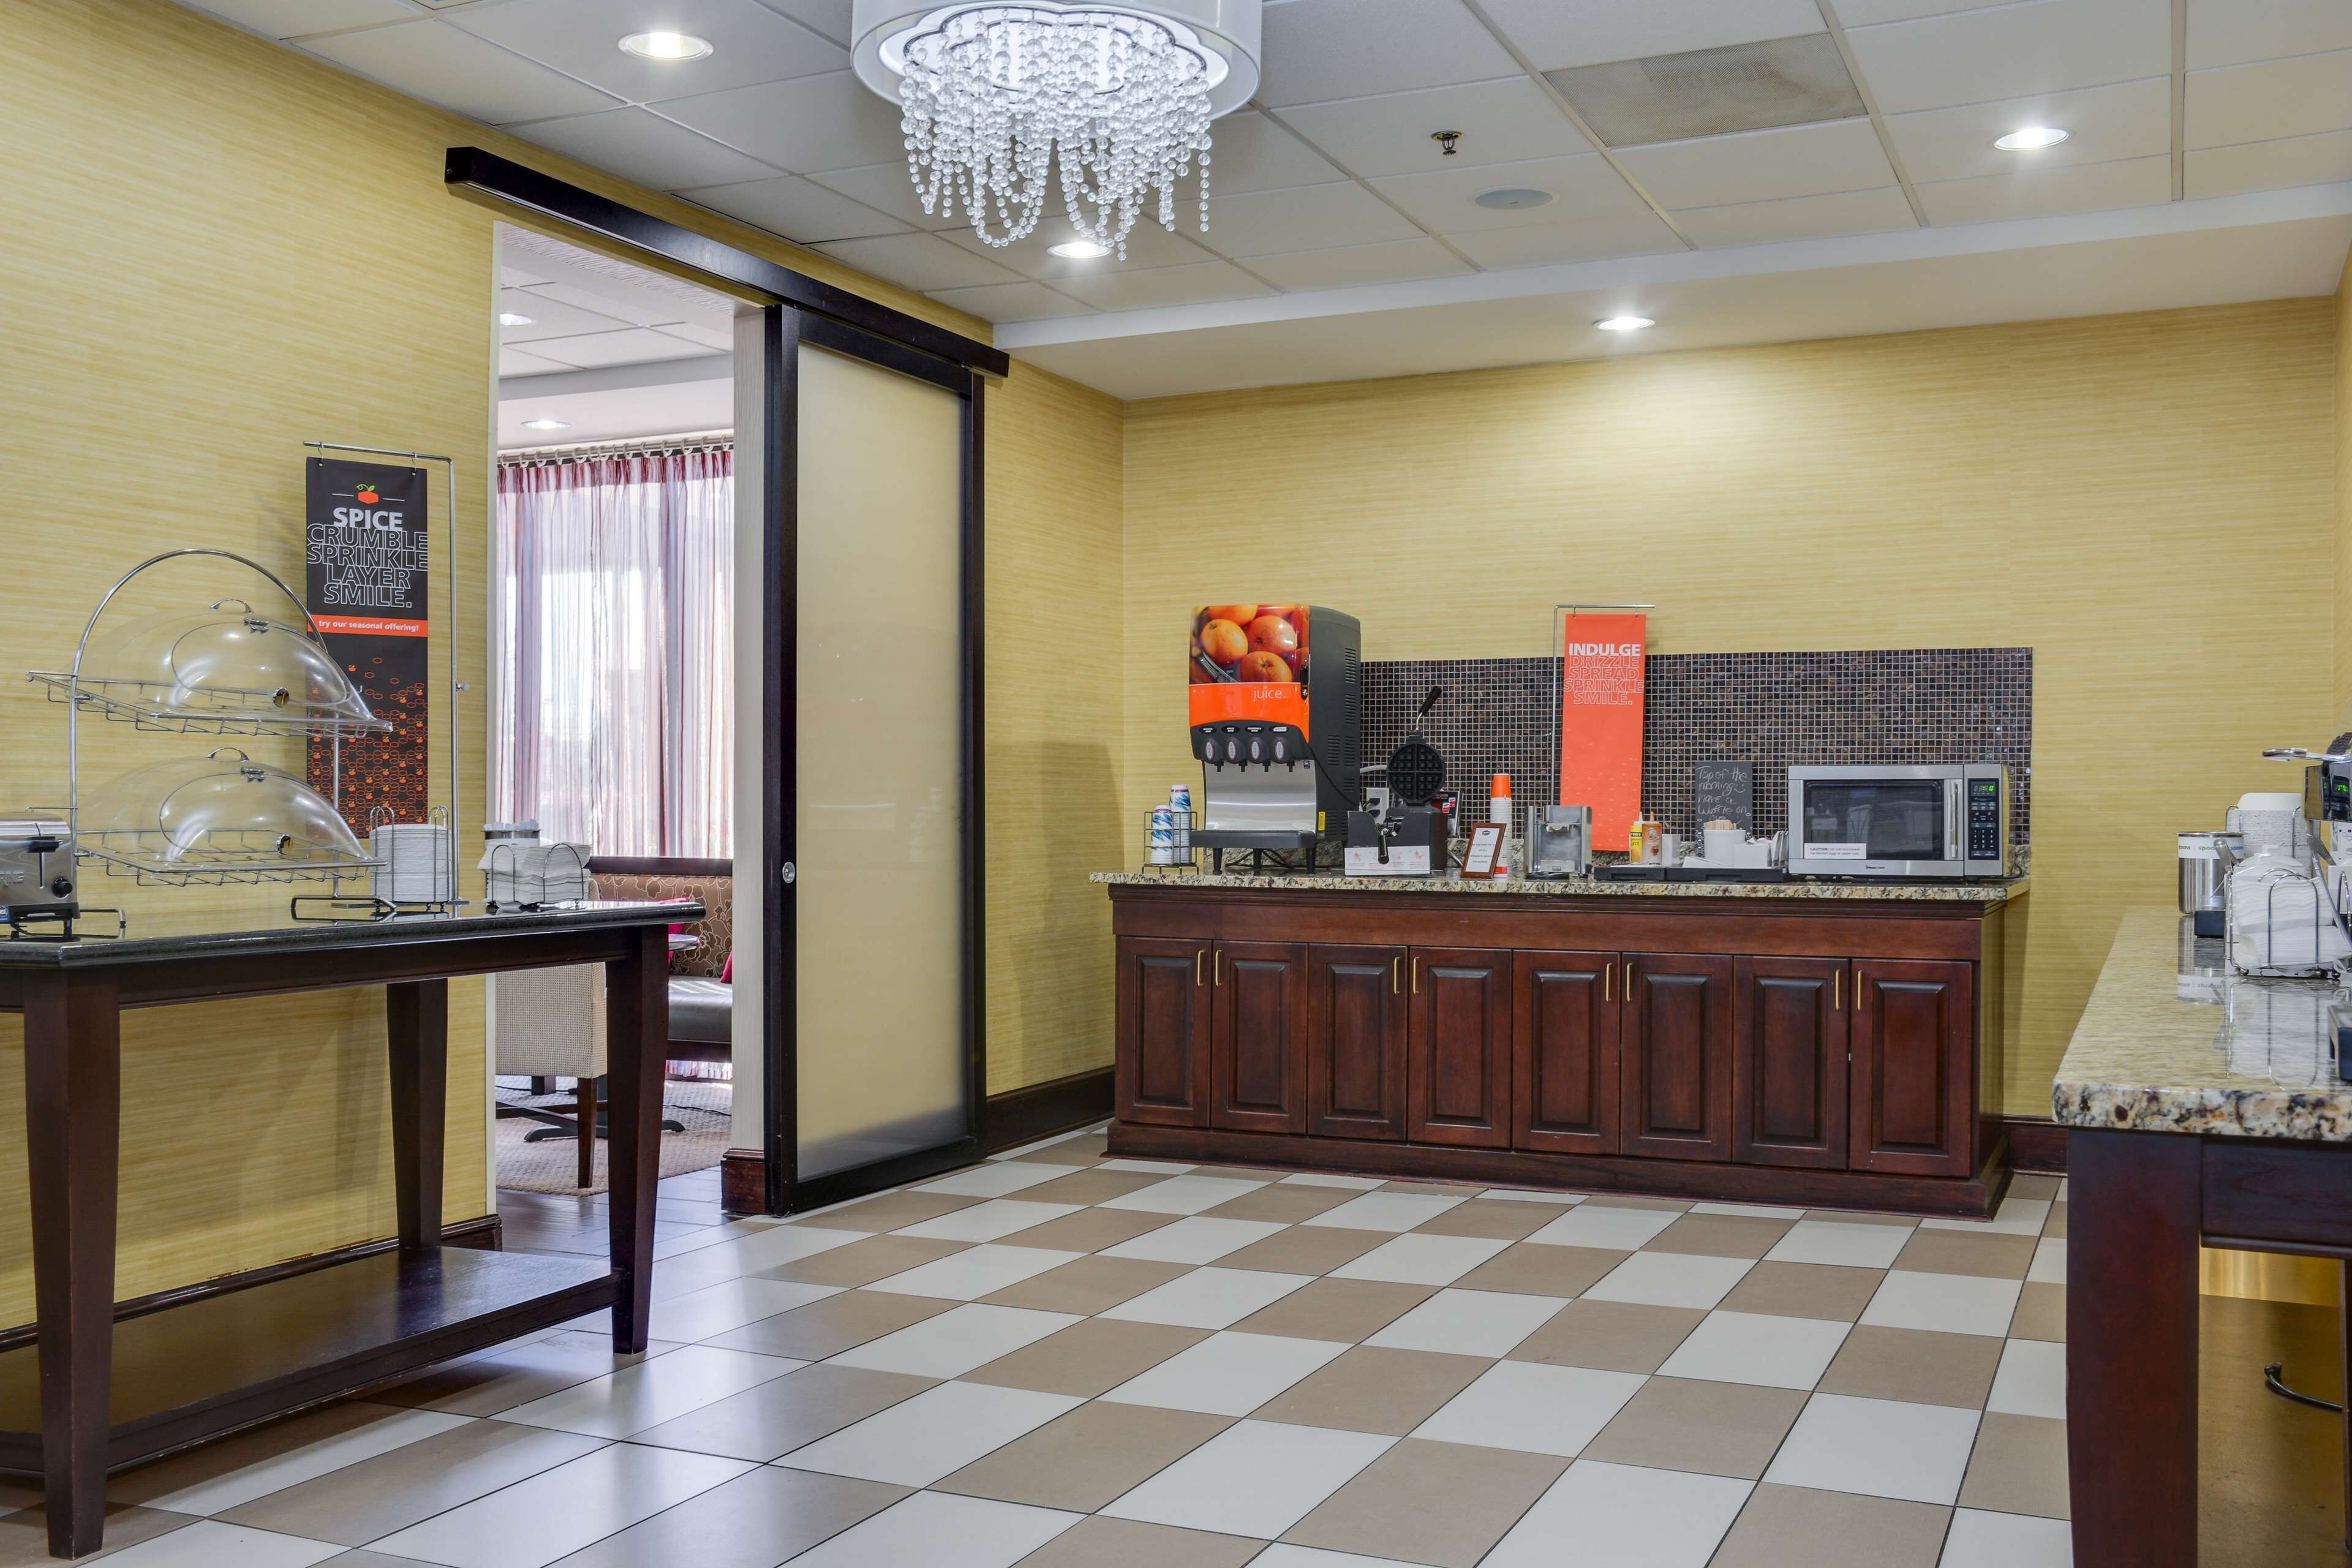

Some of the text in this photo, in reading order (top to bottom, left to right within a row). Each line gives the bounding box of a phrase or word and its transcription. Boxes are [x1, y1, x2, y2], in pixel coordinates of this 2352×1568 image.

[333, 507, 403, 531] SPICE
[307, 523, 428, 552] CRUMBLE
[307, 543, 428, 571] SPRINKLE
[326, 563, 411, 589] LAYER
[324, 582, 412, 608] SMILE.
[385, 622, 419, 633] offering!
[1569, 643, 1642, 657] INDULGE
[1569, 655, 1639, 668] DRIZZLE
[1569, 666, 1640, 680] SPREAD
[1563, 679, 1644, 693] SPRINKLE
[1252, 685, 1283, 703] juice
[1573, 691, 1633, 705] SMILE.
[1715, 769, 1729, 779] of
